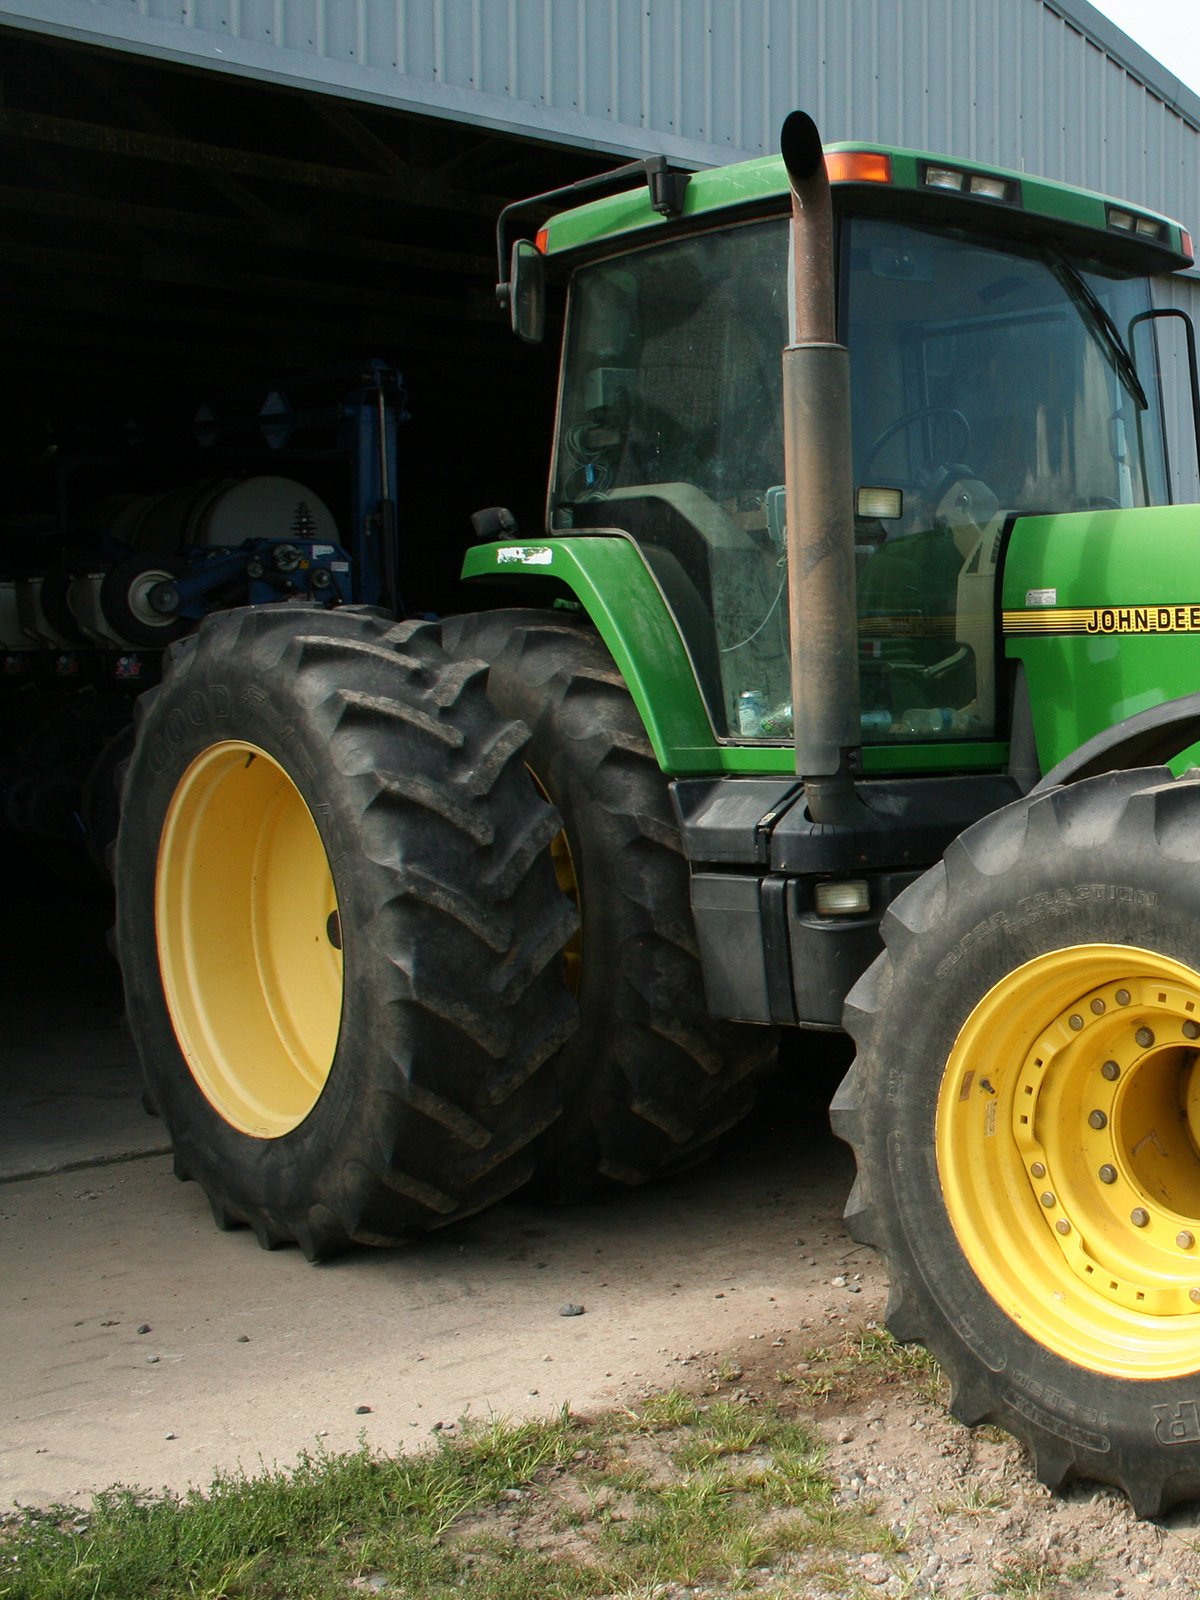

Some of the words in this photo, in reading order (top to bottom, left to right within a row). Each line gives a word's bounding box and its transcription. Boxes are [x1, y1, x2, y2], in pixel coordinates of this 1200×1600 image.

[1086, 608, 1149, 632] JOHN
[935, 910, 1009, 980] SUPER
[1016, 884, 1159, 914] TRACTION
